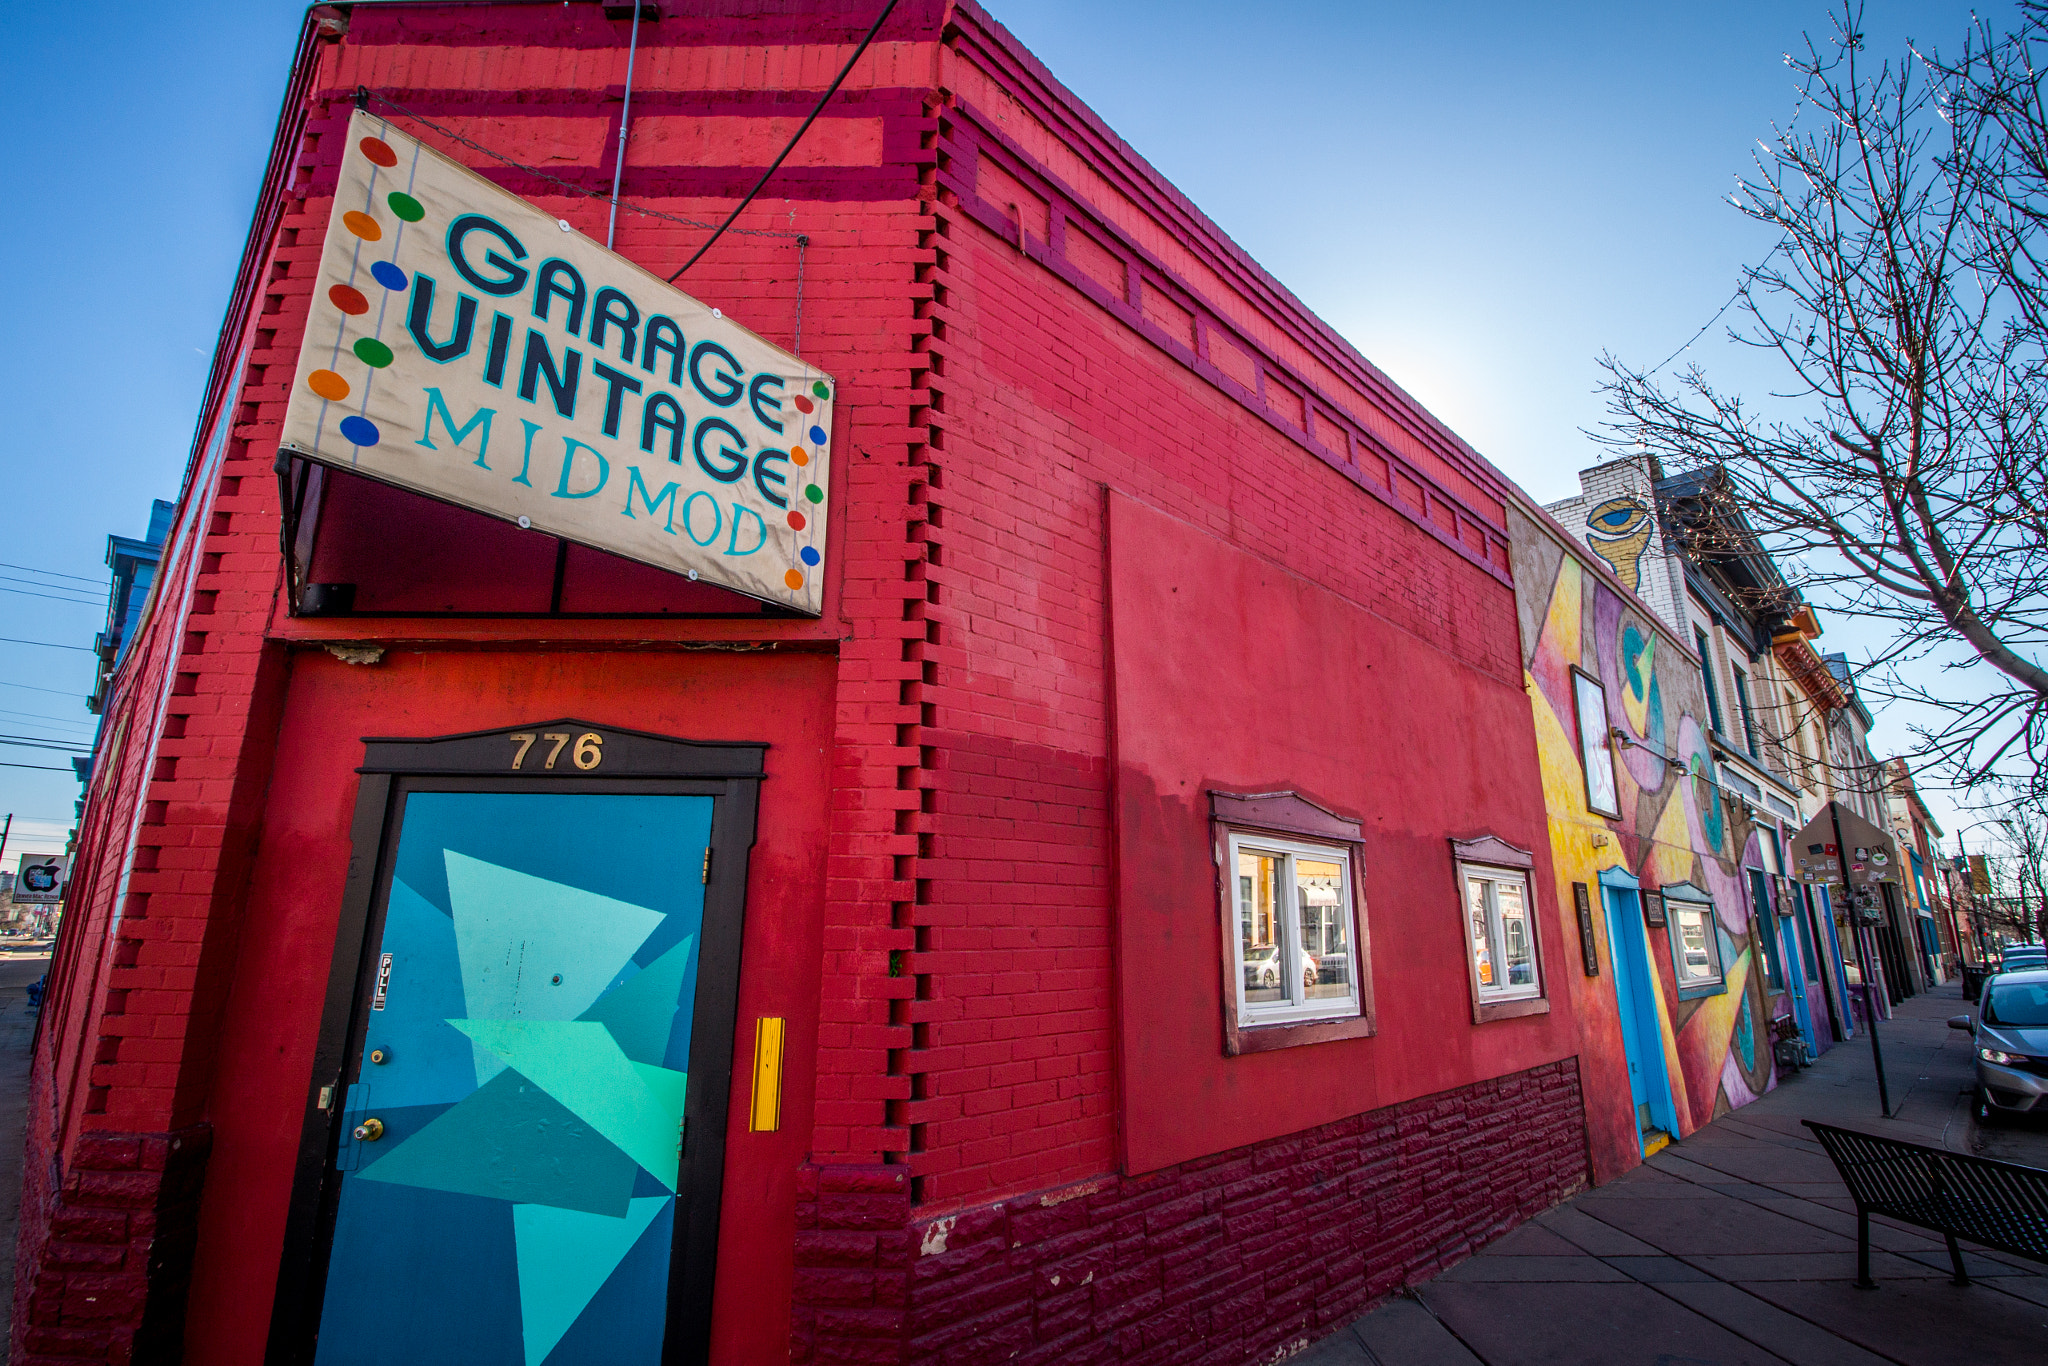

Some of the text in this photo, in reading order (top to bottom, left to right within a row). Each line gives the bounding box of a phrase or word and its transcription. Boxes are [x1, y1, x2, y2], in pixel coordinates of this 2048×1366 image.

[405, 271, 790, 509] VINTAGE
[445, 213, 785, 435] GARAGE
[415, 387, 768, 556] MID MOD
[510, 733, 603, 770] 776
[377, 957, 391, 997] PULL
